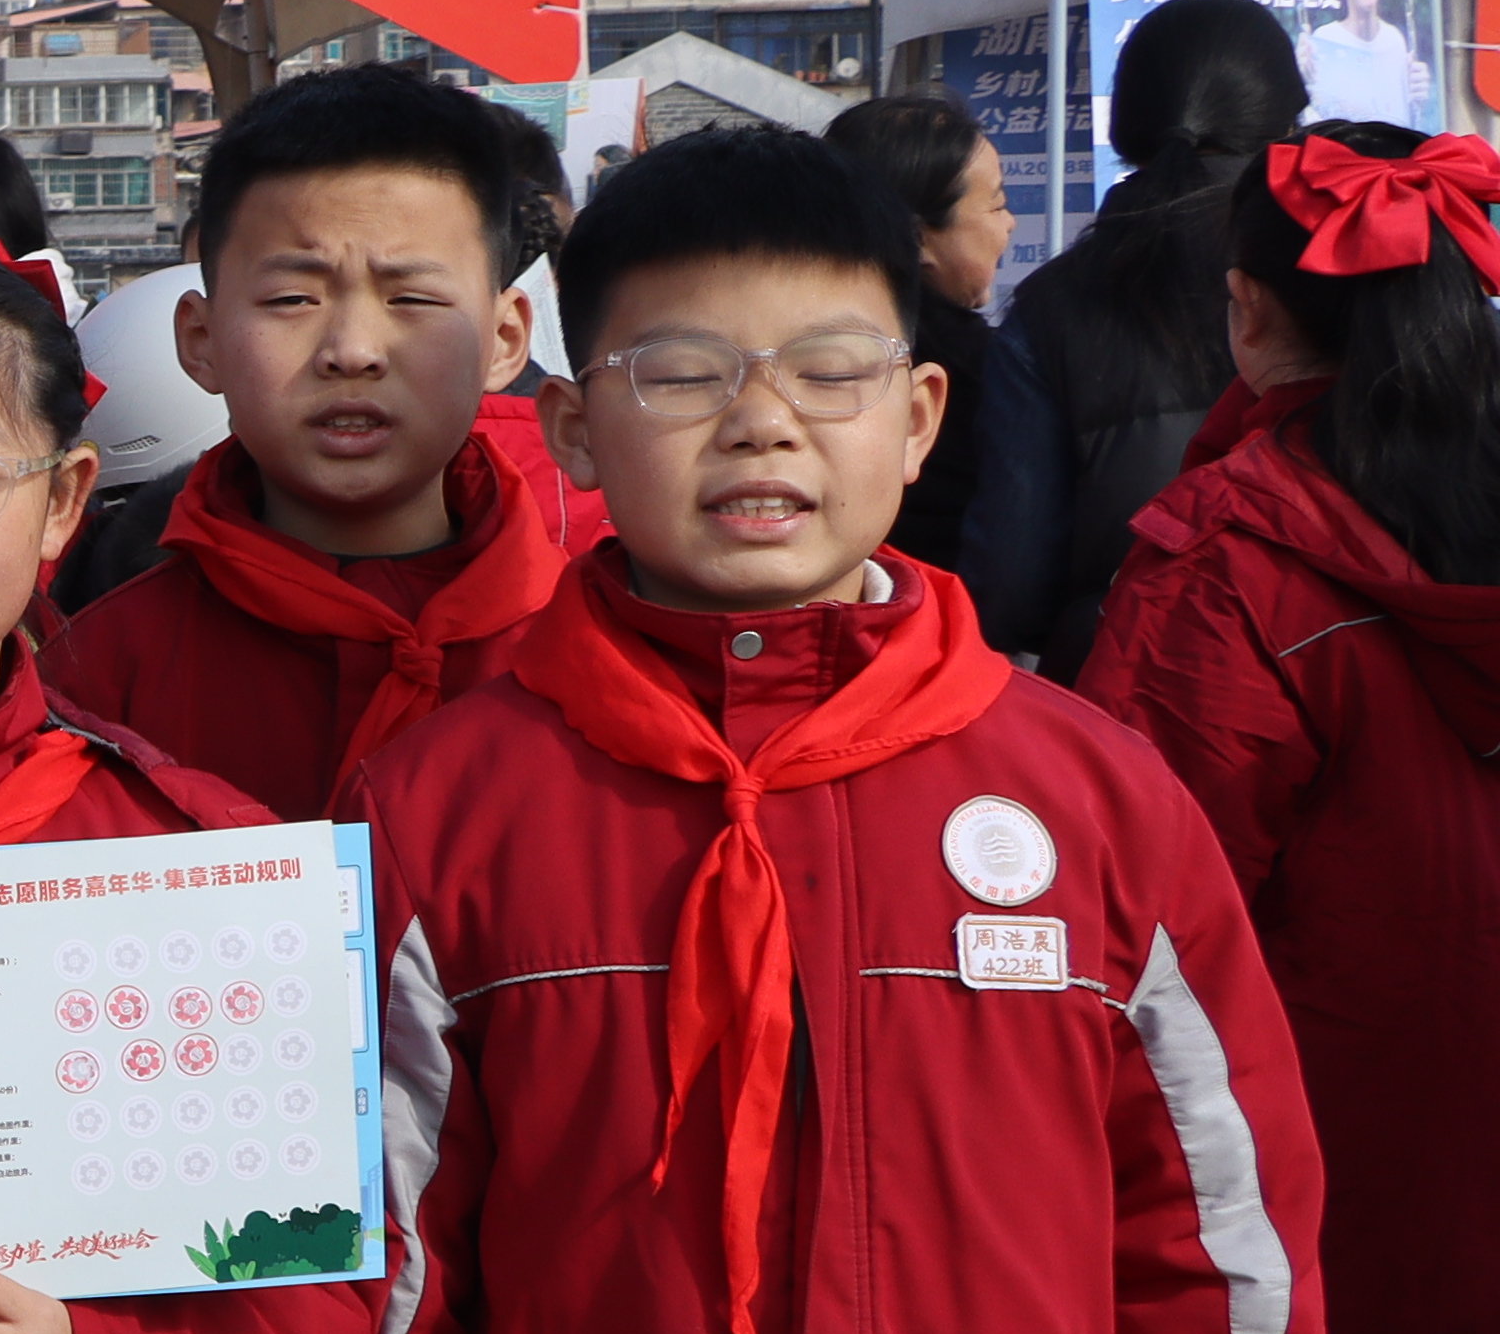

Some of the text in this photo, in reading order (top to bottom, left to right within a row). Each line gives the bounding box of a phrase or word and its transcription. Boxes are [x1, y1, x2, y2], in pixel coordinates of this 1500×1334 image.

[972, 928, 1057, 953] 周浩晨
[983, 957, 1047, 977] 422班
